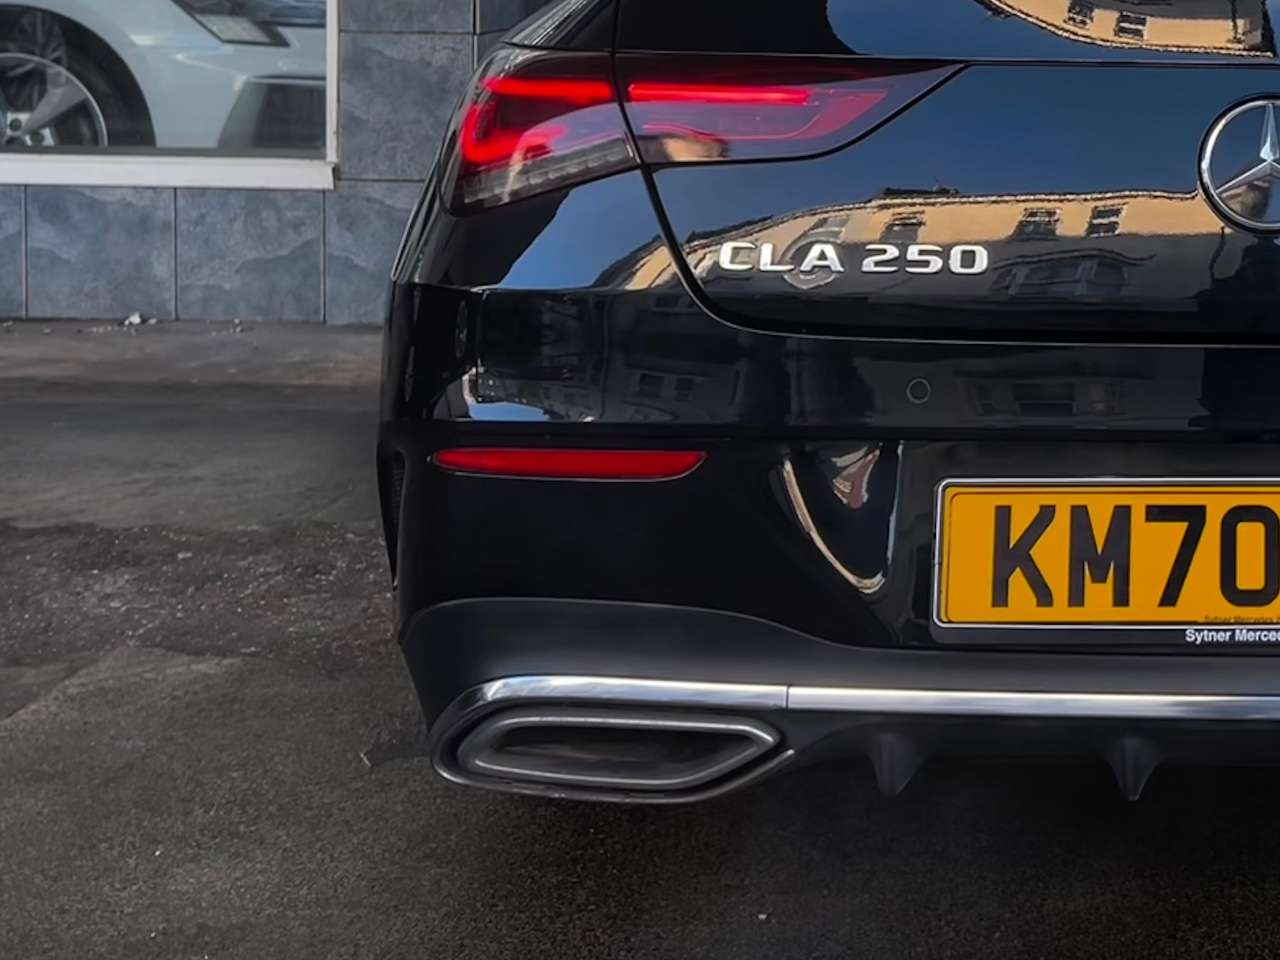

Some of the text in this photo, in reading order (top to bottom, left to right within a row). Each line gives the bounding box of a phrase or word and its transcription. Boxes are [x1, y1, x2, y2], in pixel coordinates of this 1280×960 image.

[719, 241, 989, 275] CLA 250
[1185, 628, 1232, 644] Sytner
